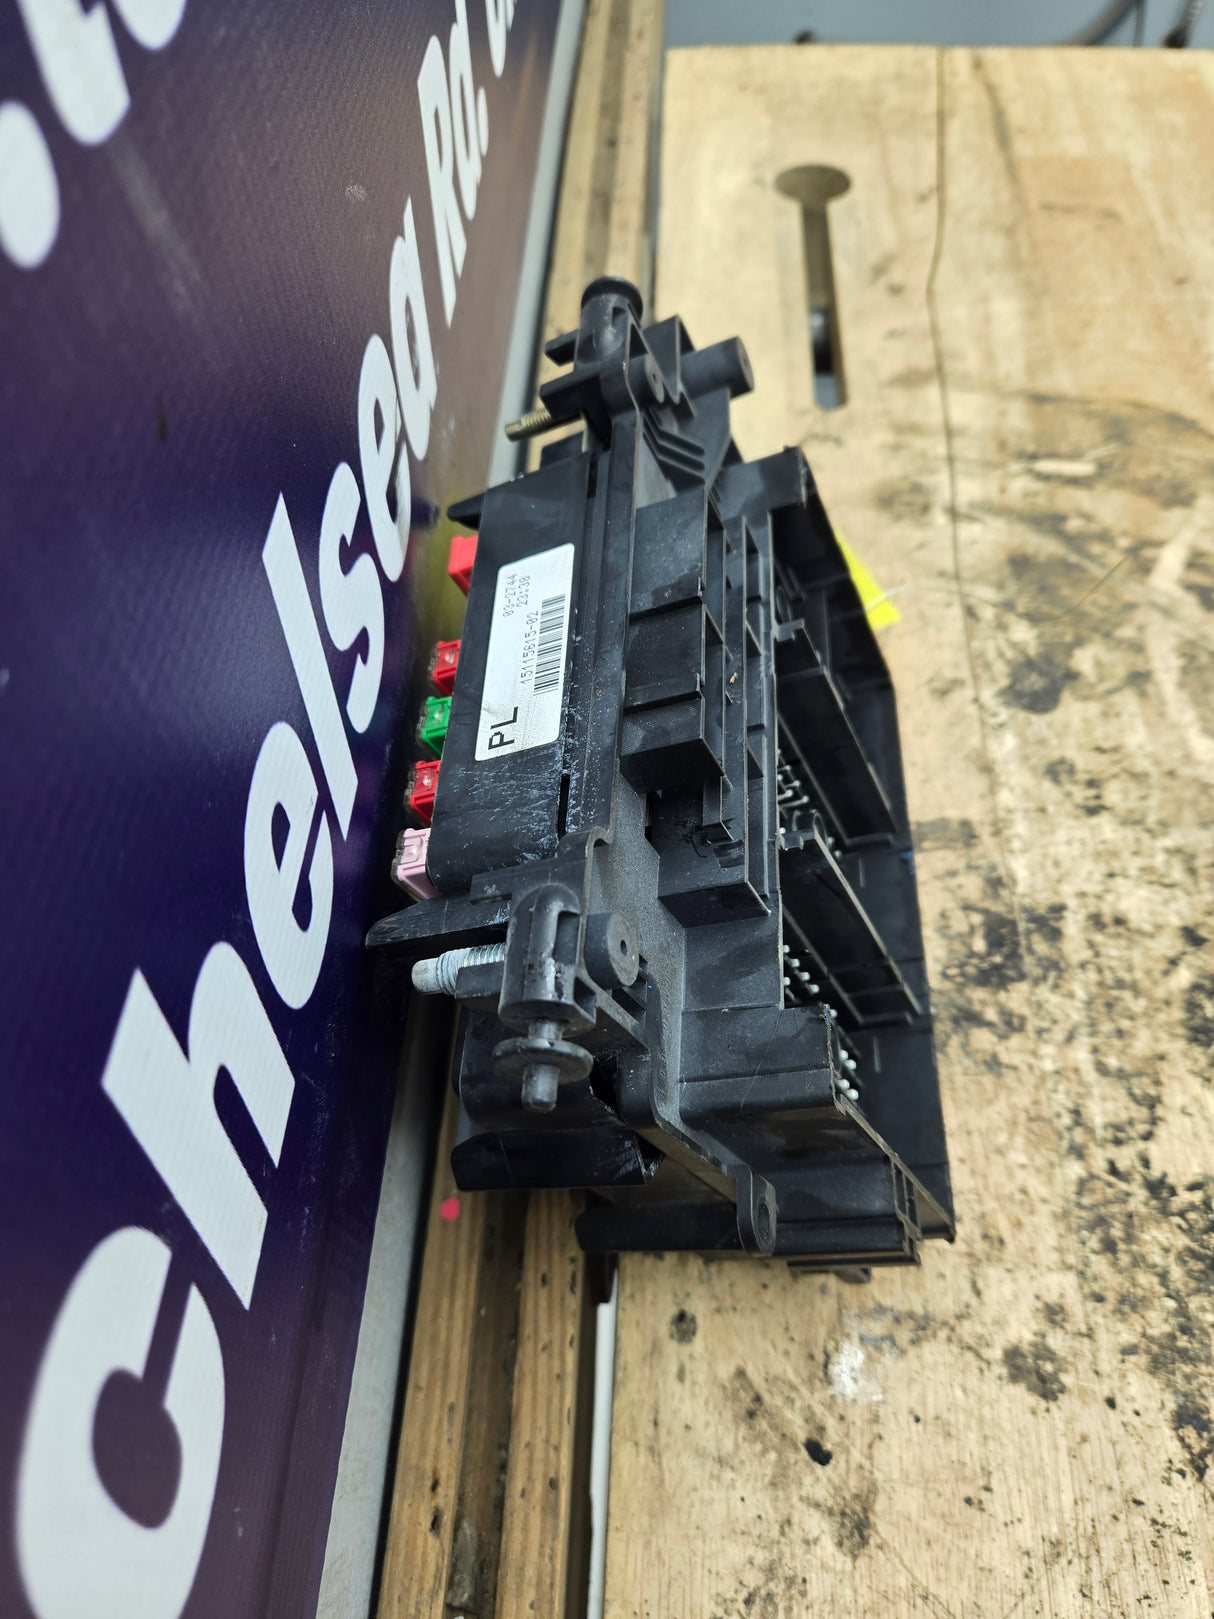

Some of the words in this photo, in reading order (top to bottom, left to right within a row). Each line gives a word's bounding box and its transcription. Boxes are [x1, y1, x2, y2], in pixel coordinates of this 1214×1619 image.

[503, 573, 518, 617] 03-2744
[517, 575, 531, 607] 23:38
[488, 706, 518, 750] PL
[18, 196, 437, 1619] Chelsea
[417, 0, 489, 328] Rd.
